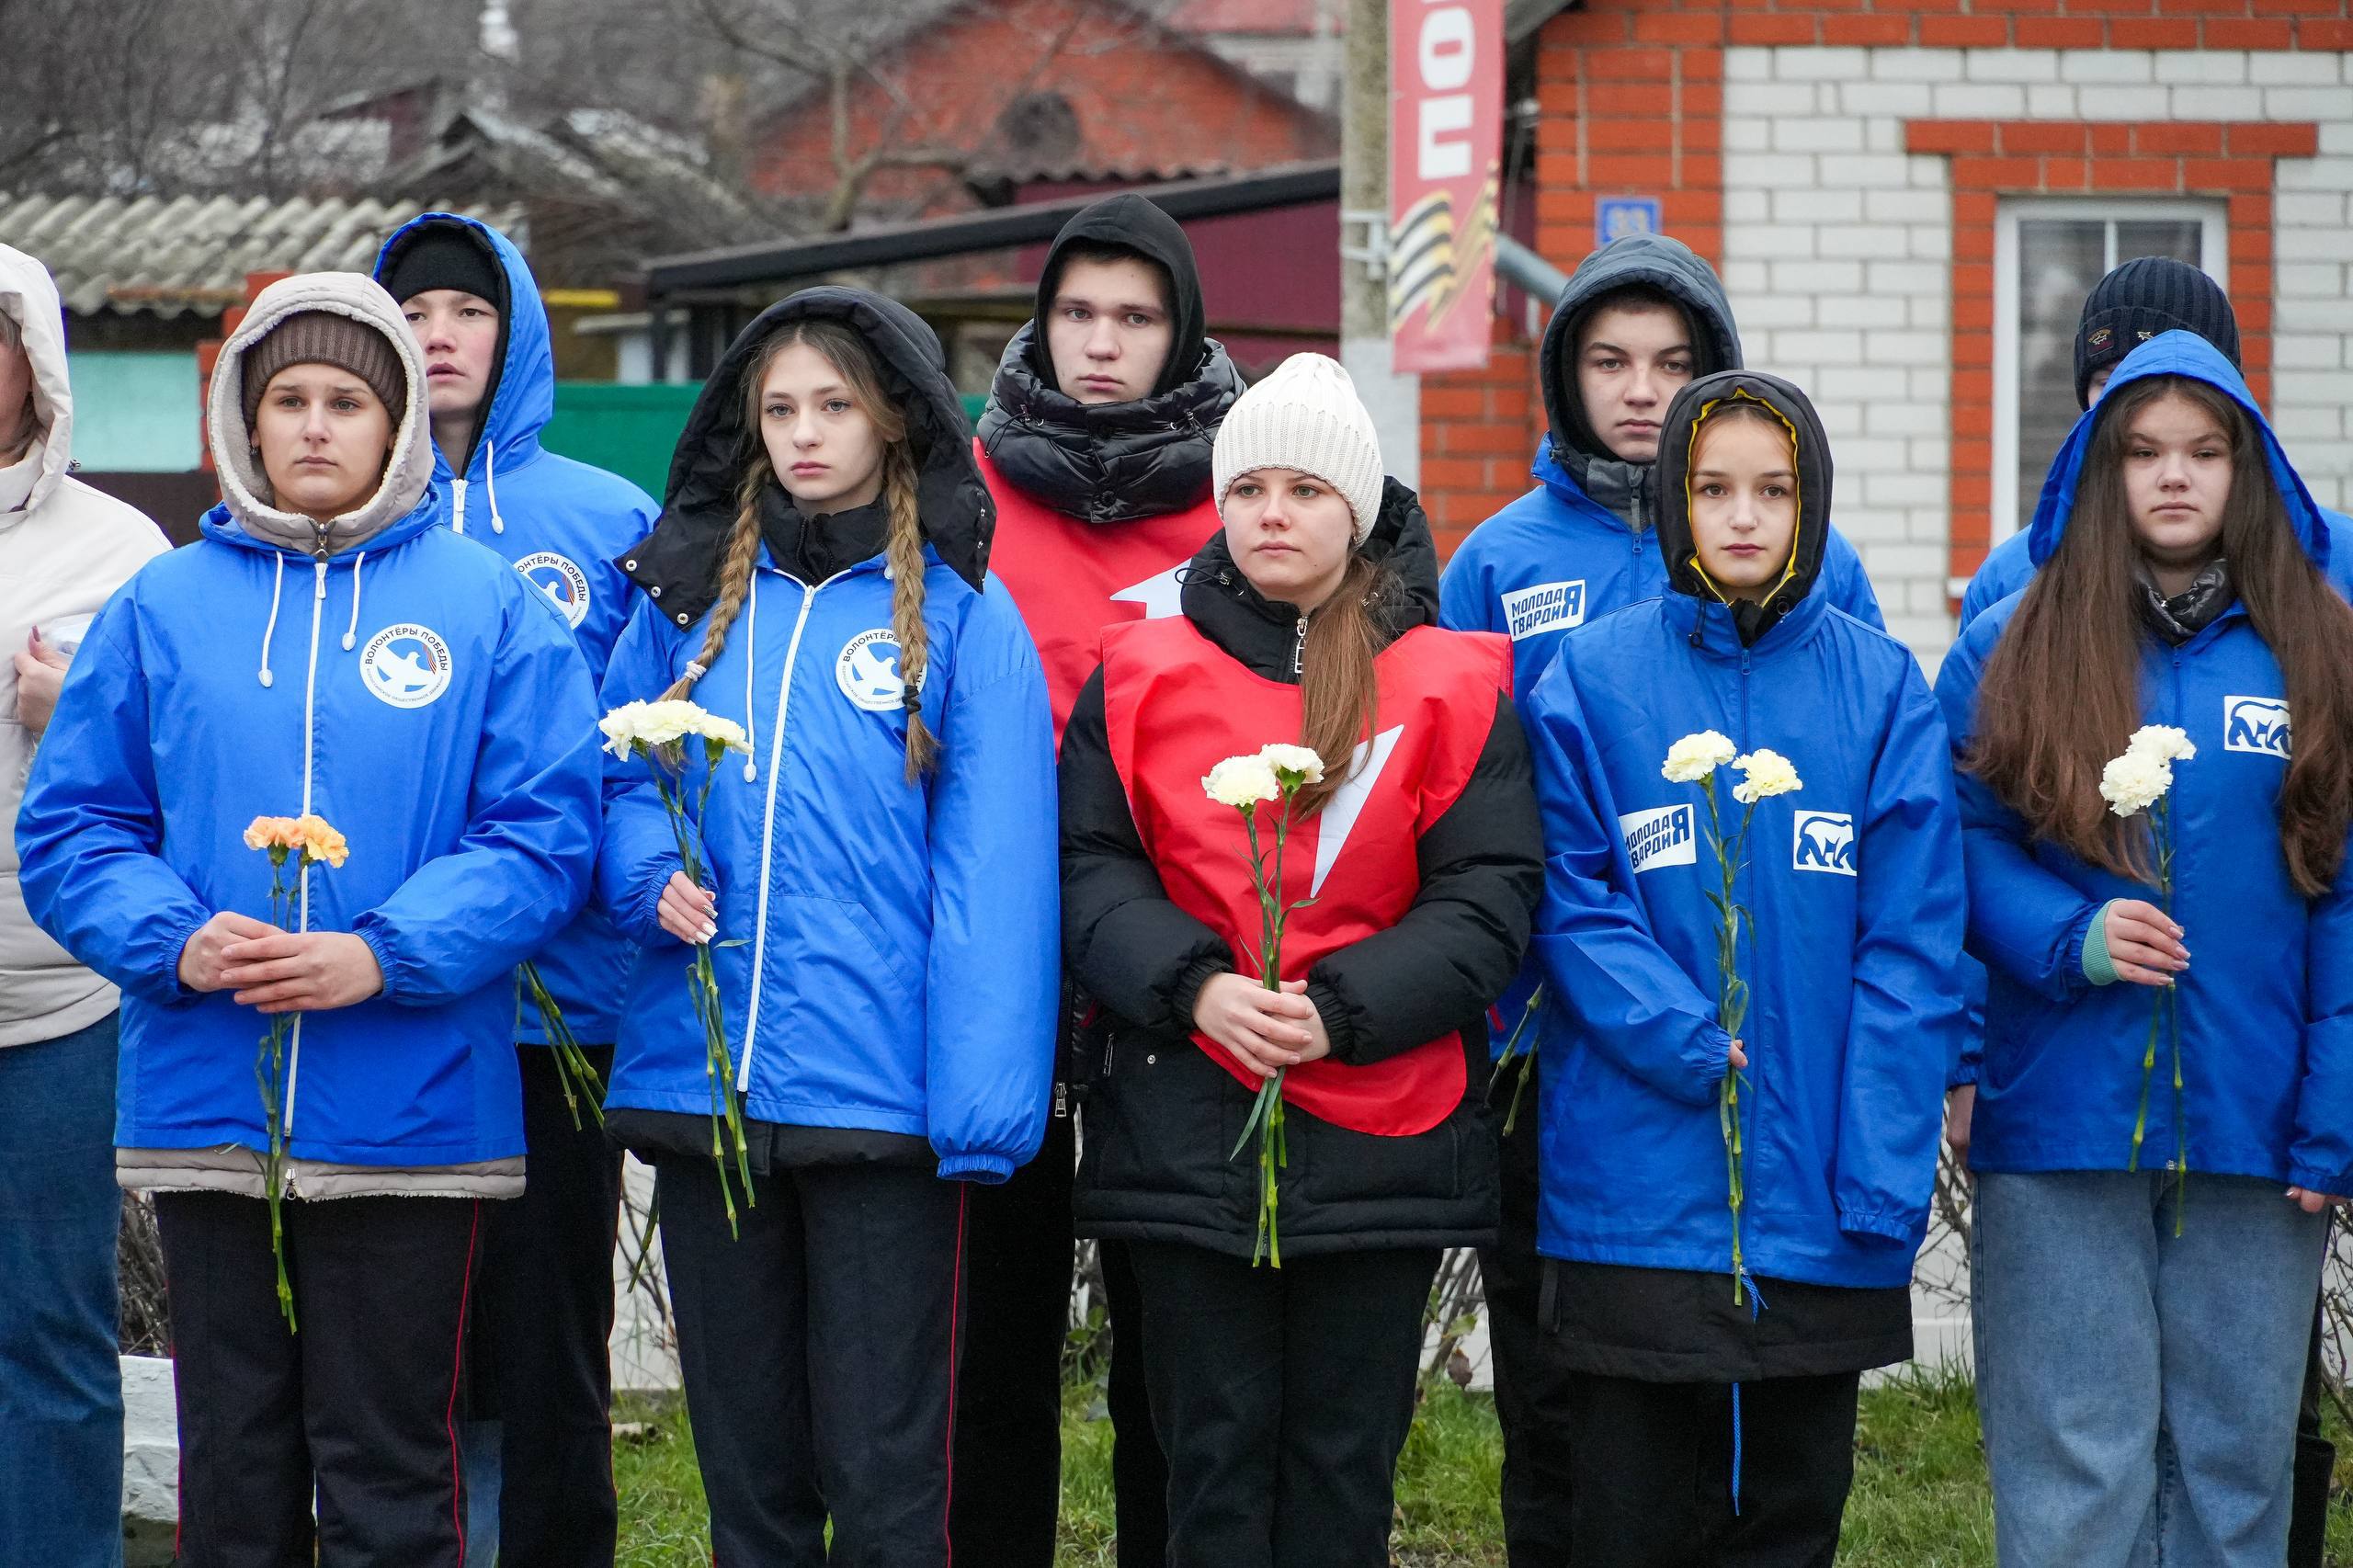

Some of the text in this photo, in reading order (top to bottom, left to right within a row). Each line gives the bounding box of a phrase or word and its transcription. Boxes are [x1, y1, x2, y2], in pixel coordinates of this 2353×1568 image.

[1418, 0, 1476, 180] ПО
[517, 555, 586, 602] ОНТЁРЫ ПОБЕДЫ
[365, 627, 448, 671] ВОЛОНТЁРЫ ПОБЕДЫ
